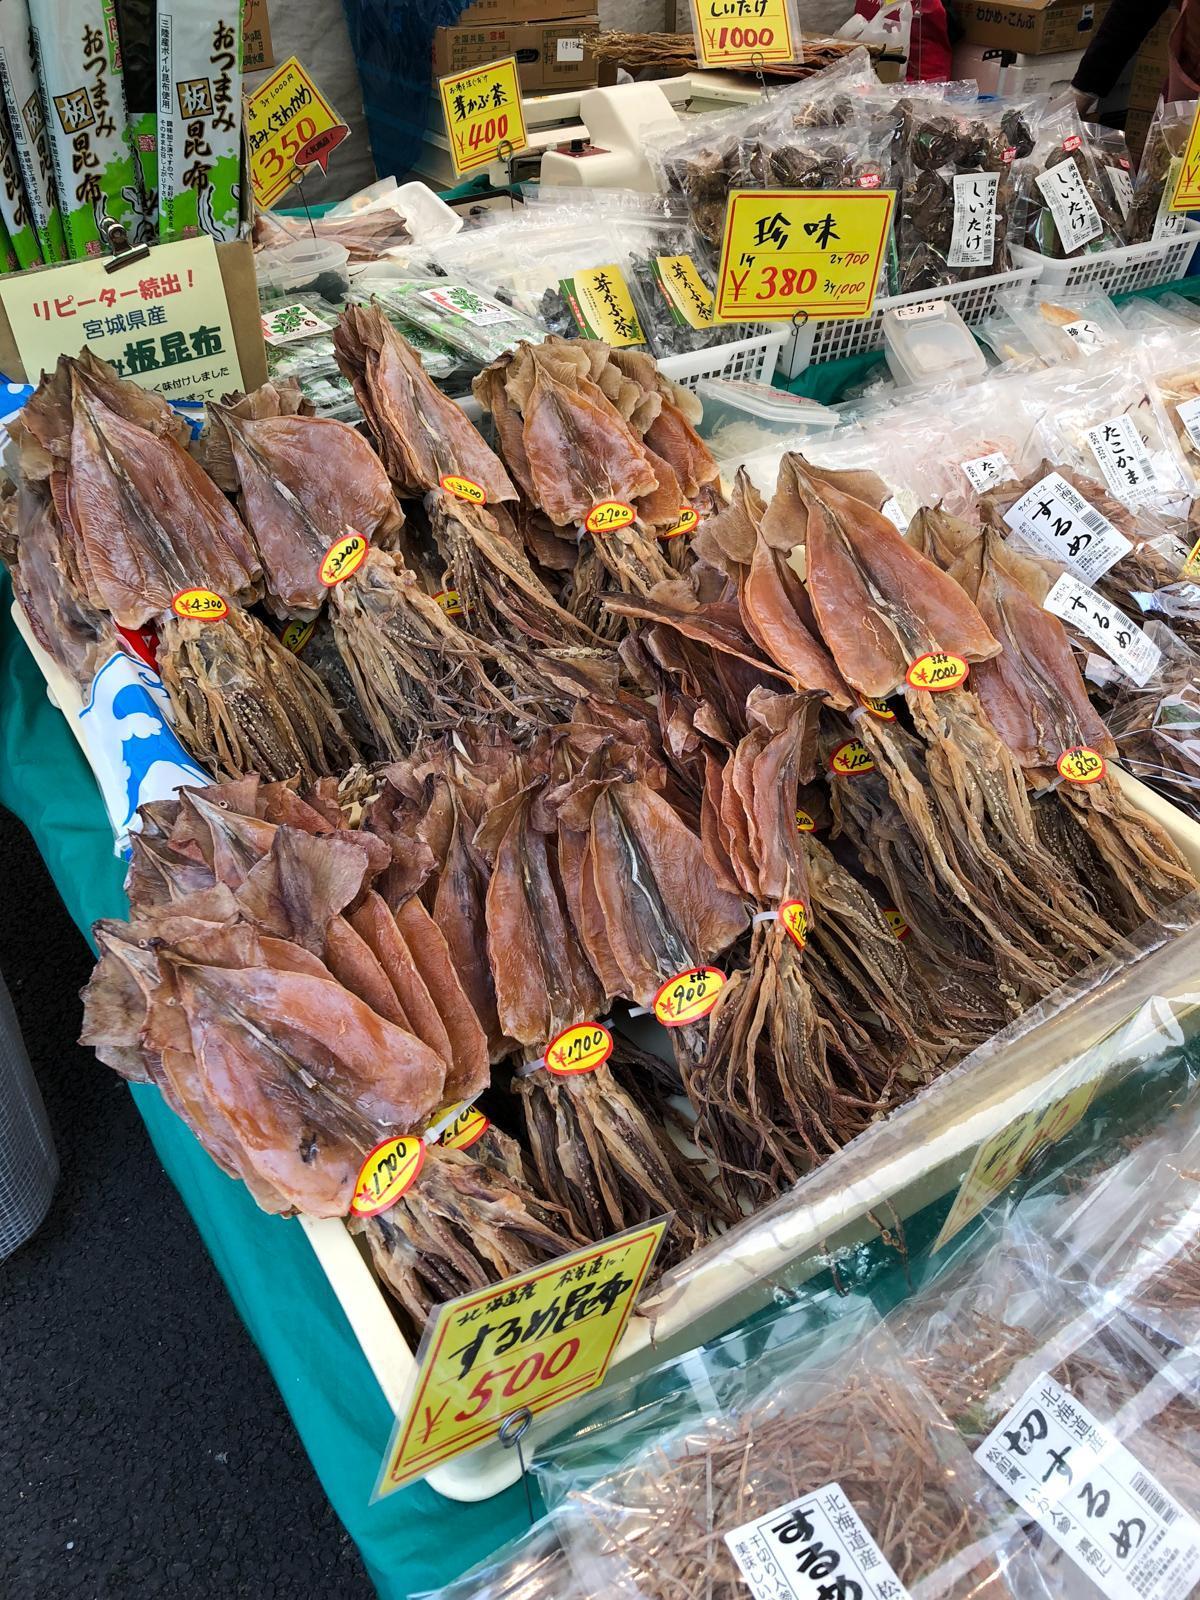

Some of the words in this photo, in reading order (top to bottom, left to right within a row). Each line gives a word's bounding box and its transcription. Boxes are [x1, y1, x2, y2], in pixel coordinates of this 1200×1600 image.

[705, 27, 774, 49] ¥1000
[82, 25, 117, 138] おつまみ
[210, 20, 237, 132] おつまみ
[252, 116, 317, 190] ¥350
[456, 113, 509, 154] ¥400
[965, 182, 984, 250] しいたけ
[1056, 172, 1087, 230] しいたけ
[753, 212, 840, 250] 珍味
[728, 266, 818, 302] ¥380
[83, 306, 168, 340] 宮城県産
[1102, 426, 1140, 485] たこかま
[1031, 499, 1093, 556] するめ
[181, 598, 222, 613] ¥4300
[1069, 596, 1132, 649] するめ
[659, 982, 707, 1018] ¥900
[448, 1271, 633, 1381] するめ昆布
[416, 1337, 580, 1444] ¥500
[1040, 1387, 1108, 1454] 北海道産
[1003, 1408, 1146, 1558] 切するめ
[824, 1493, 881, 1572] 北海道産
